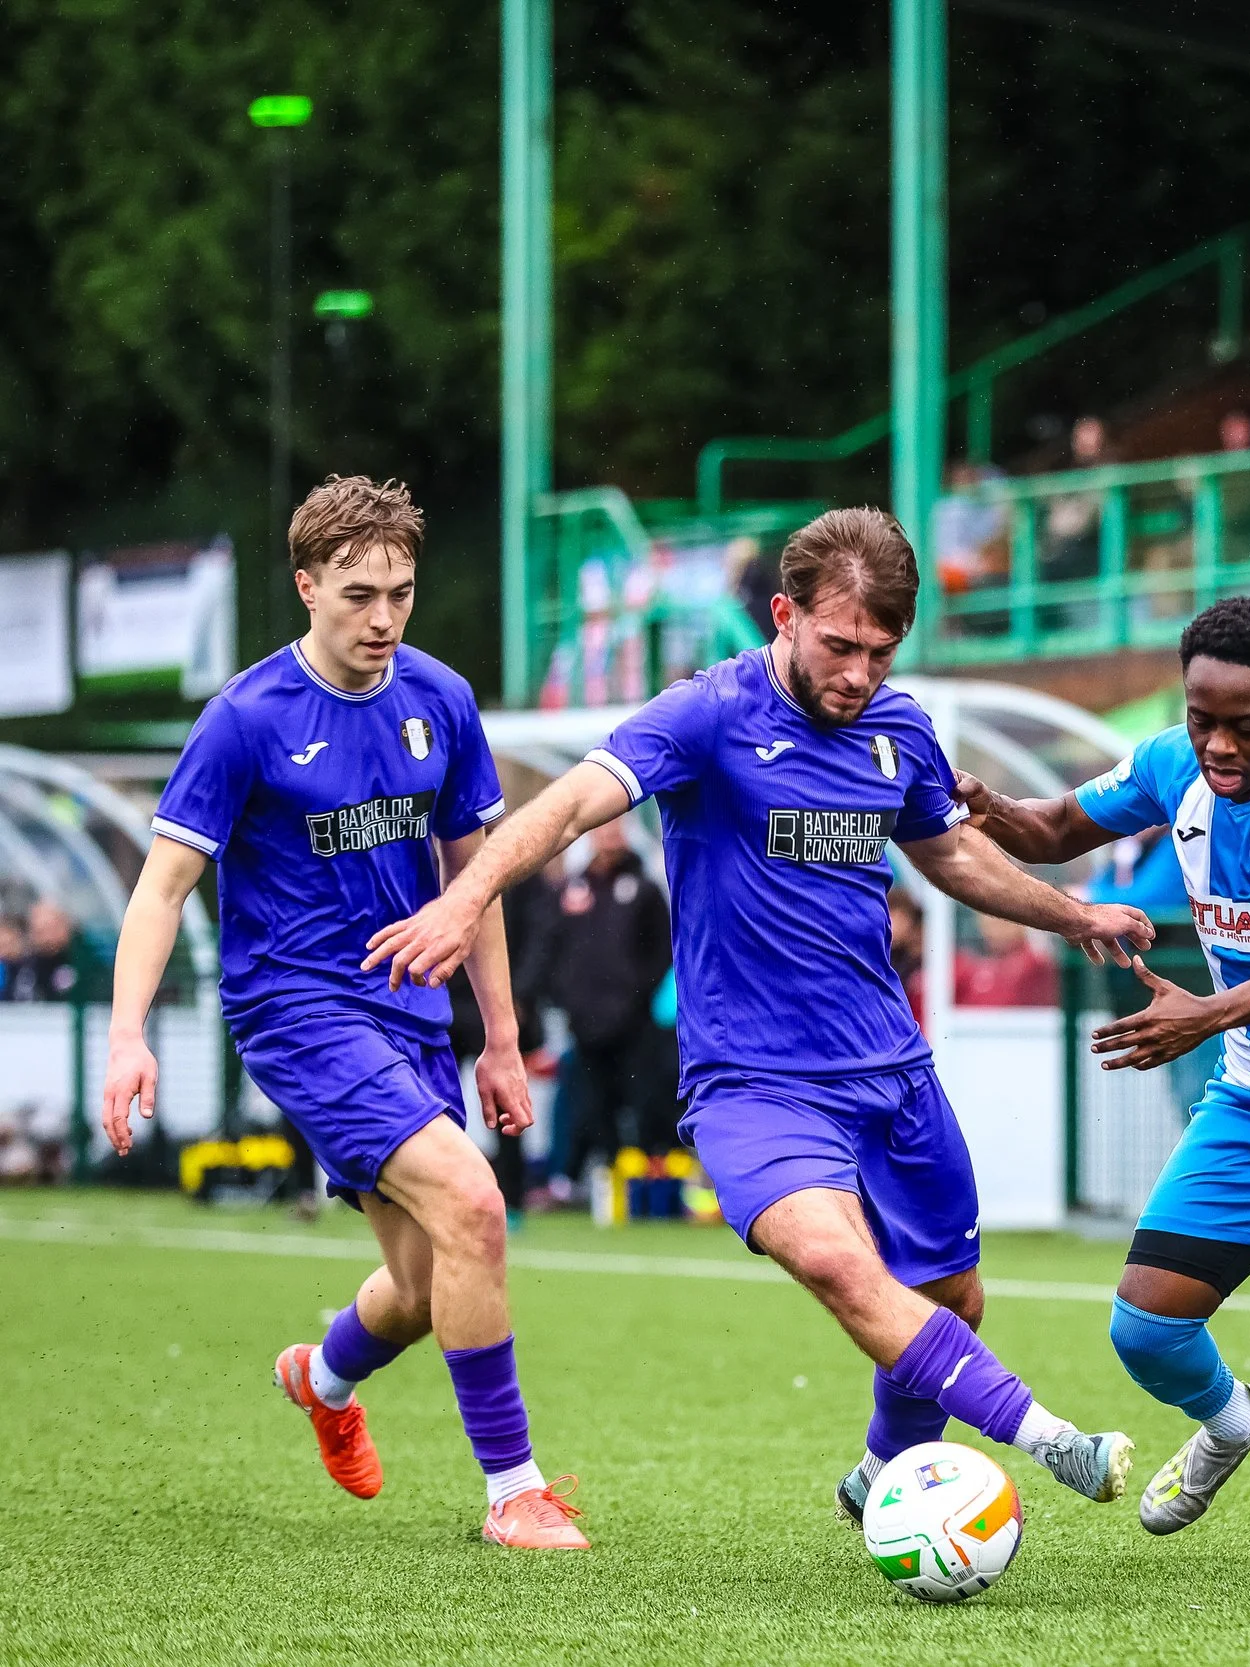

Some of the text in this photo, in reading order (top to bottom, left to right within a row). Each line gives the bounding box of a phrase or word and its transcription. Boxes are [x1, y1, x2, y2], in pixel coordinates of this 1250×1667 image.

[338, 797, 414, 829] BATCHELOR
[804, 811, 881, 836] BATCHELOR
[1219, 930, 1225, 938] &
